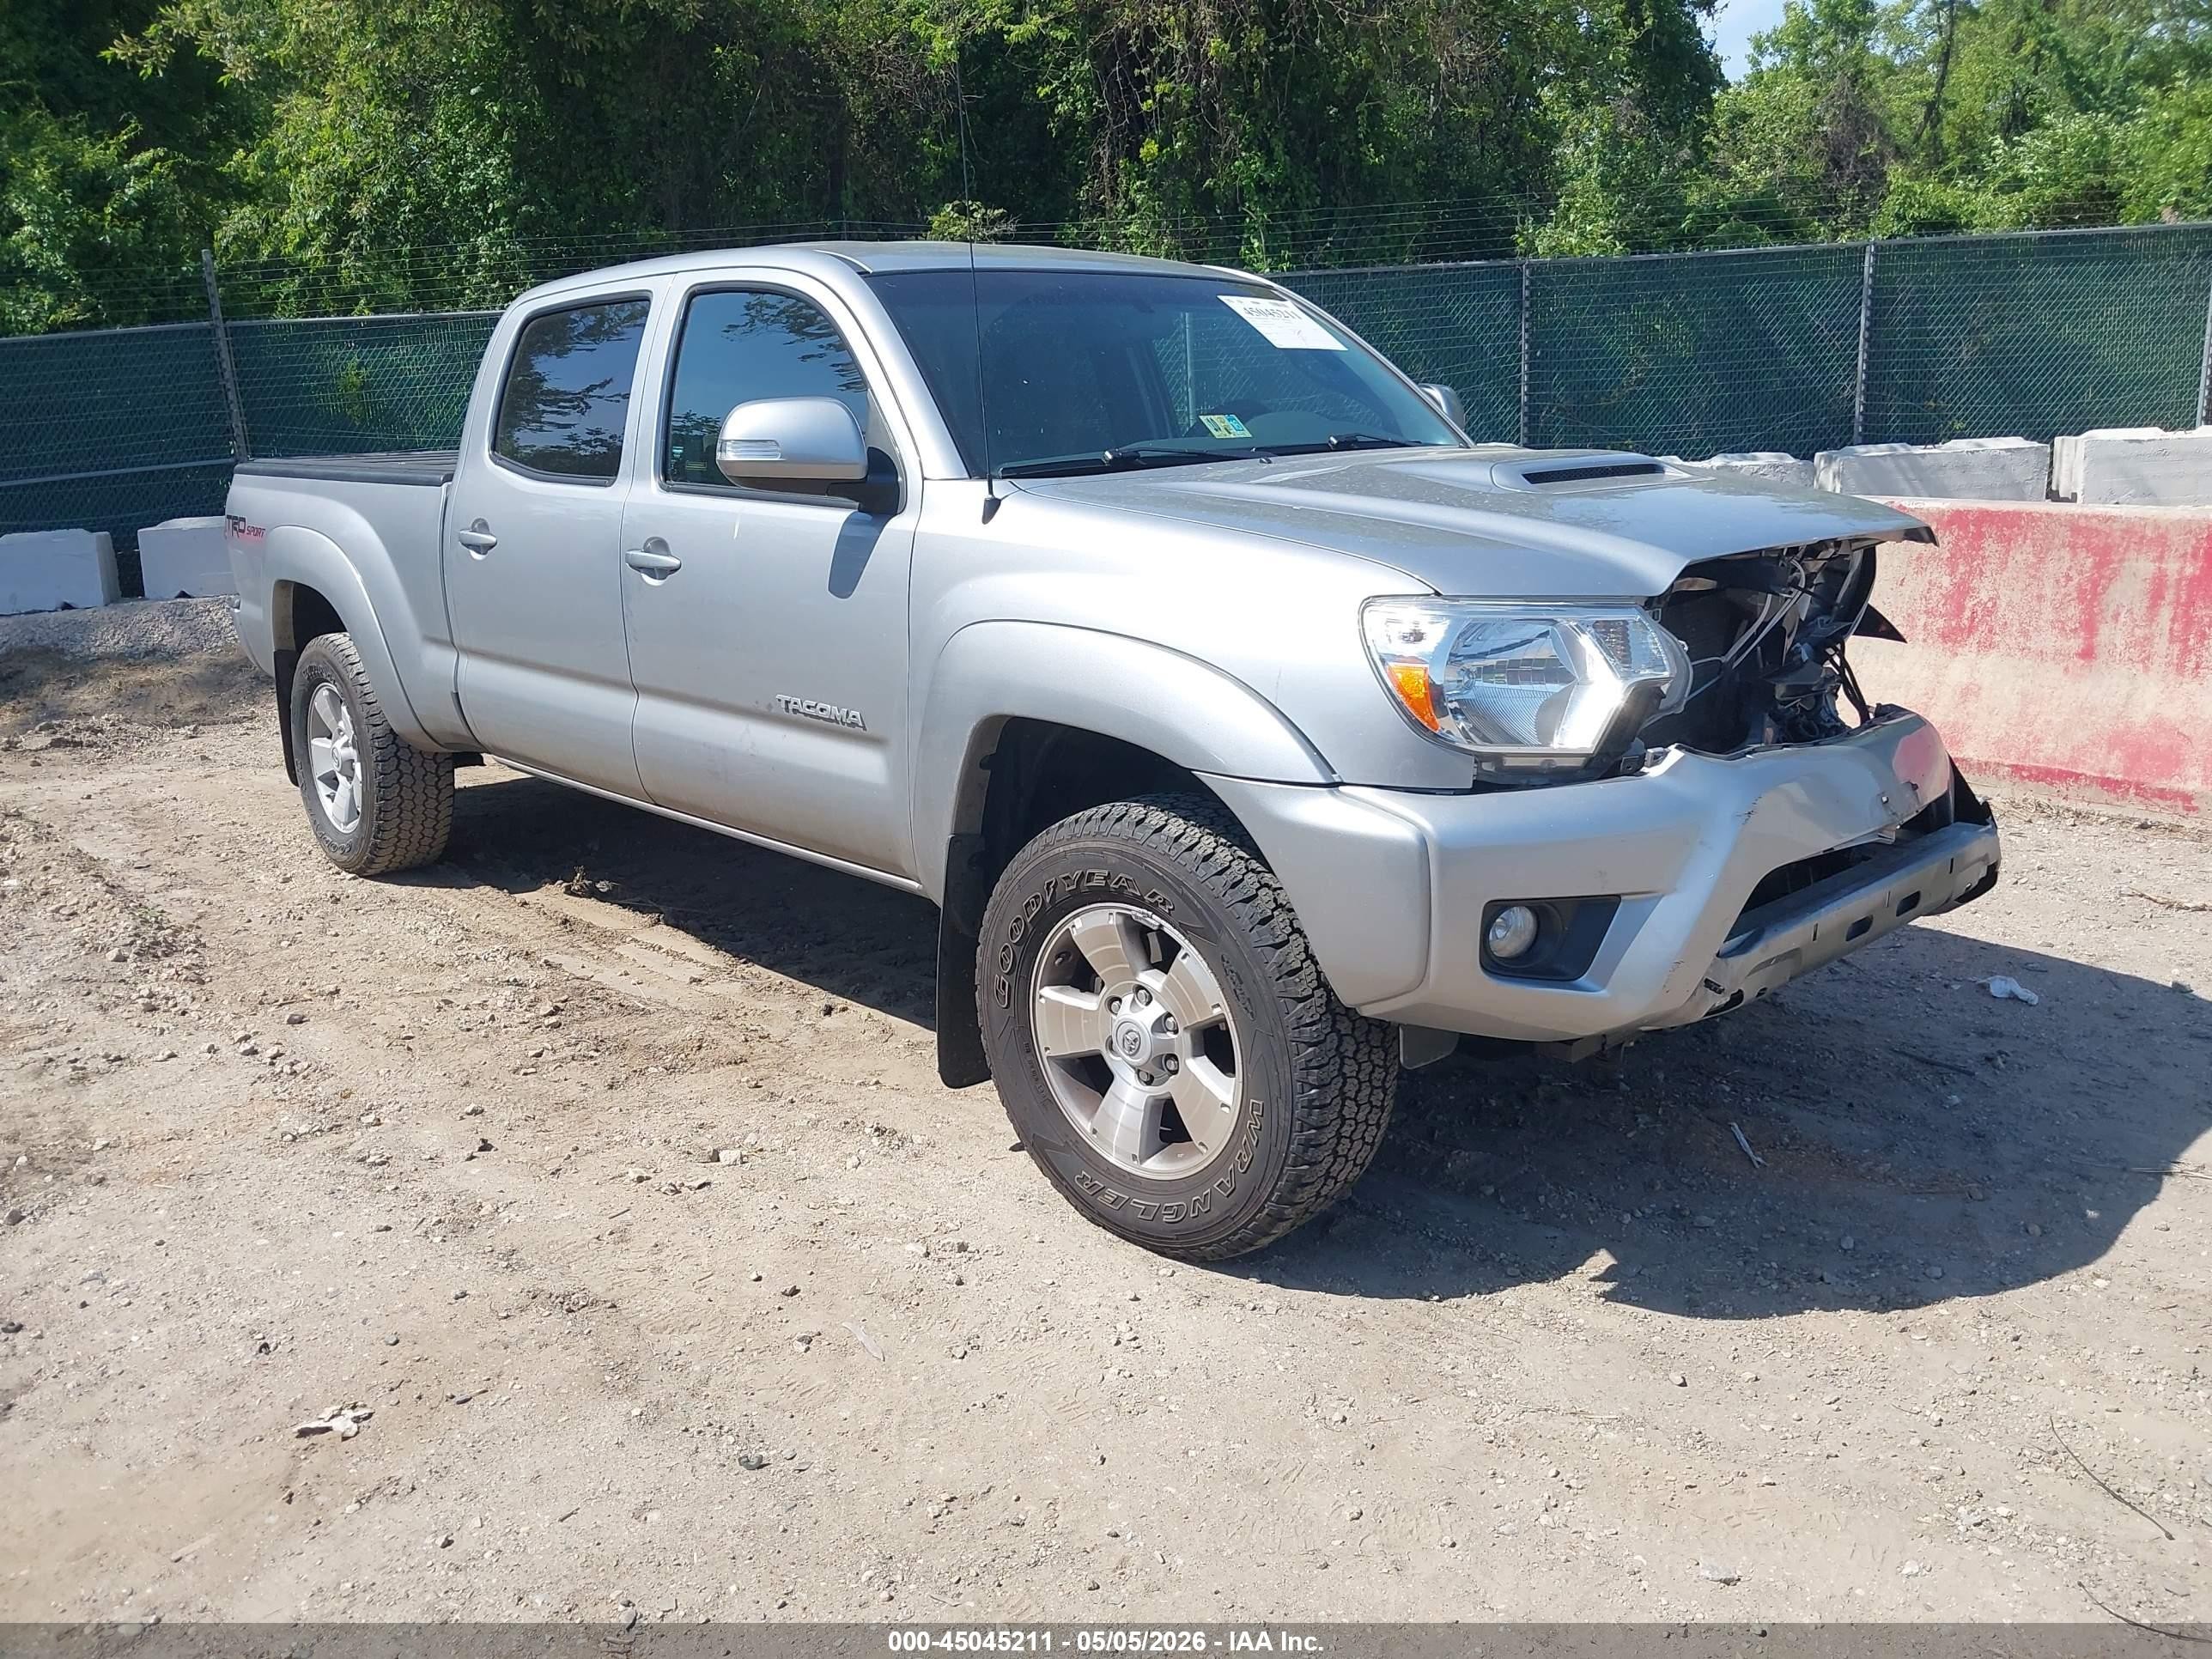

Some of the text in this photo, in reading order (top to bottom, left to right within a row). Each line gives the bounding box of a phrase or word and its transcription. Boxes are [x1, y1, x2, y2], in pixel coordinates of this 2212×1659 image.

[227, 514, 266, 538] TRD SPORT
[775, 694, 866, 730] TACOMA
[994, 867, 1176, 1009] GOODYEAR
[1074, 1098, 1263, 1223] WRANGLER
